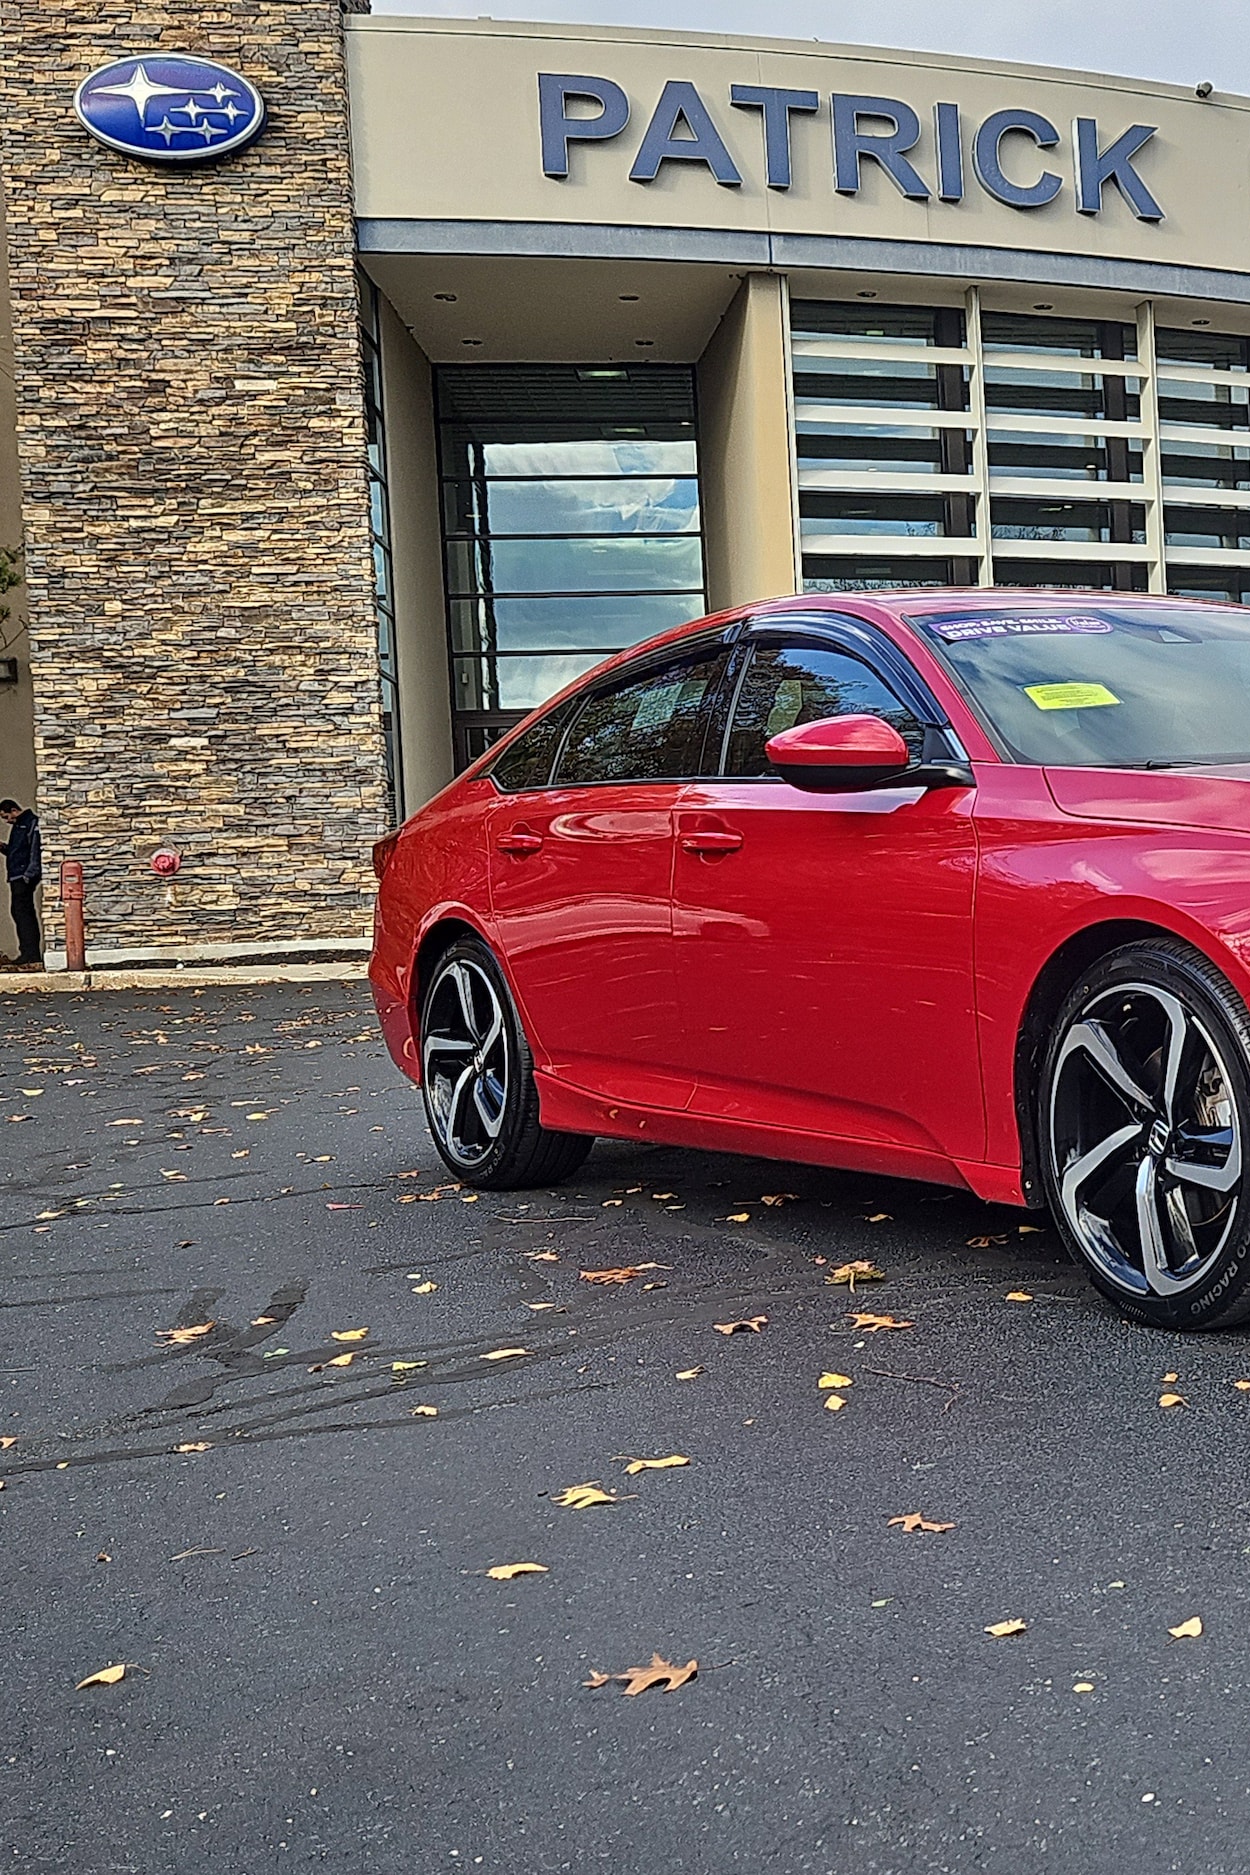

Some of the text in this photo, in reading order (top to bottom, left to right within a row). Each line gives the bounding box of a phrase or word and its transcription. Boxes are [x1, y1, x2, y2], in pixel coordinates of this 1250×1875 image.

[538, 72, 1167, 222] PATRICK
[946, 626, 1007, 637] DRIVE
[1190, 1260, 1239, 1314] RACING
